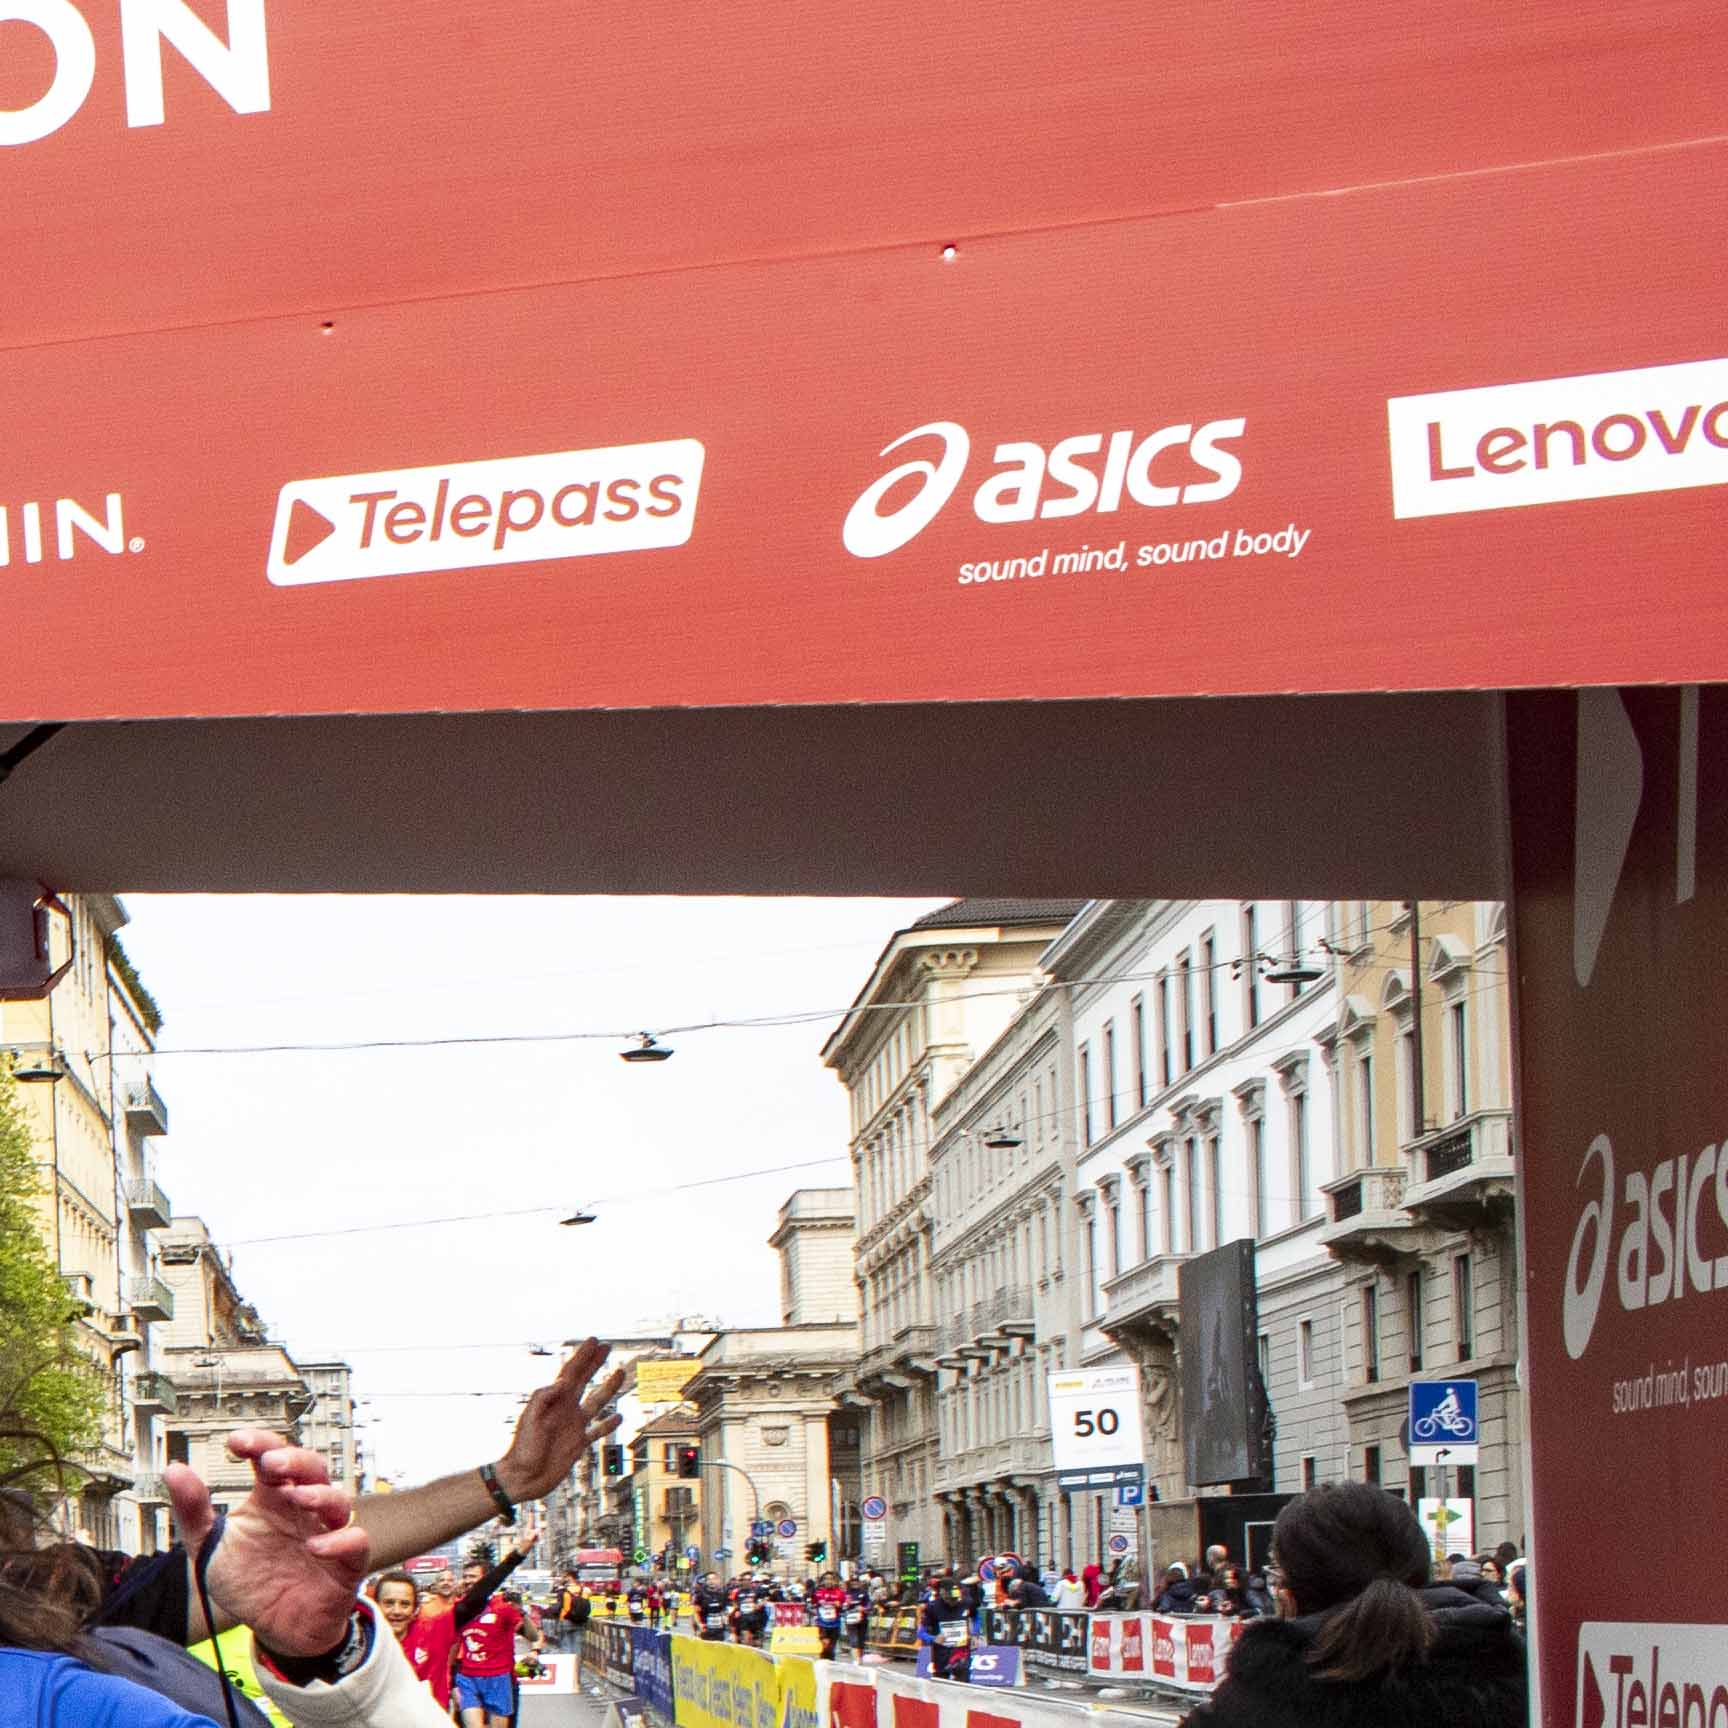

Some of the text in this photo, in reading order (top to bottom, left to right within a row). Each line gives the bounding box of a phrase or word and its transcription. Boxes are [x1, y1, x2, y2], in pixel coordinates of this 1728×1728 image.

[1426, 396, 1728, 482] Lenovo
[350, 468, 684, 549] Telepass
[957, 522, 1311, 585] sound mind, sound body
[1612, 1363, 1654, 1414] sound
[1074, 1408, 1120, 1438] 50
[1123, 1485, 1139, 1500] P
